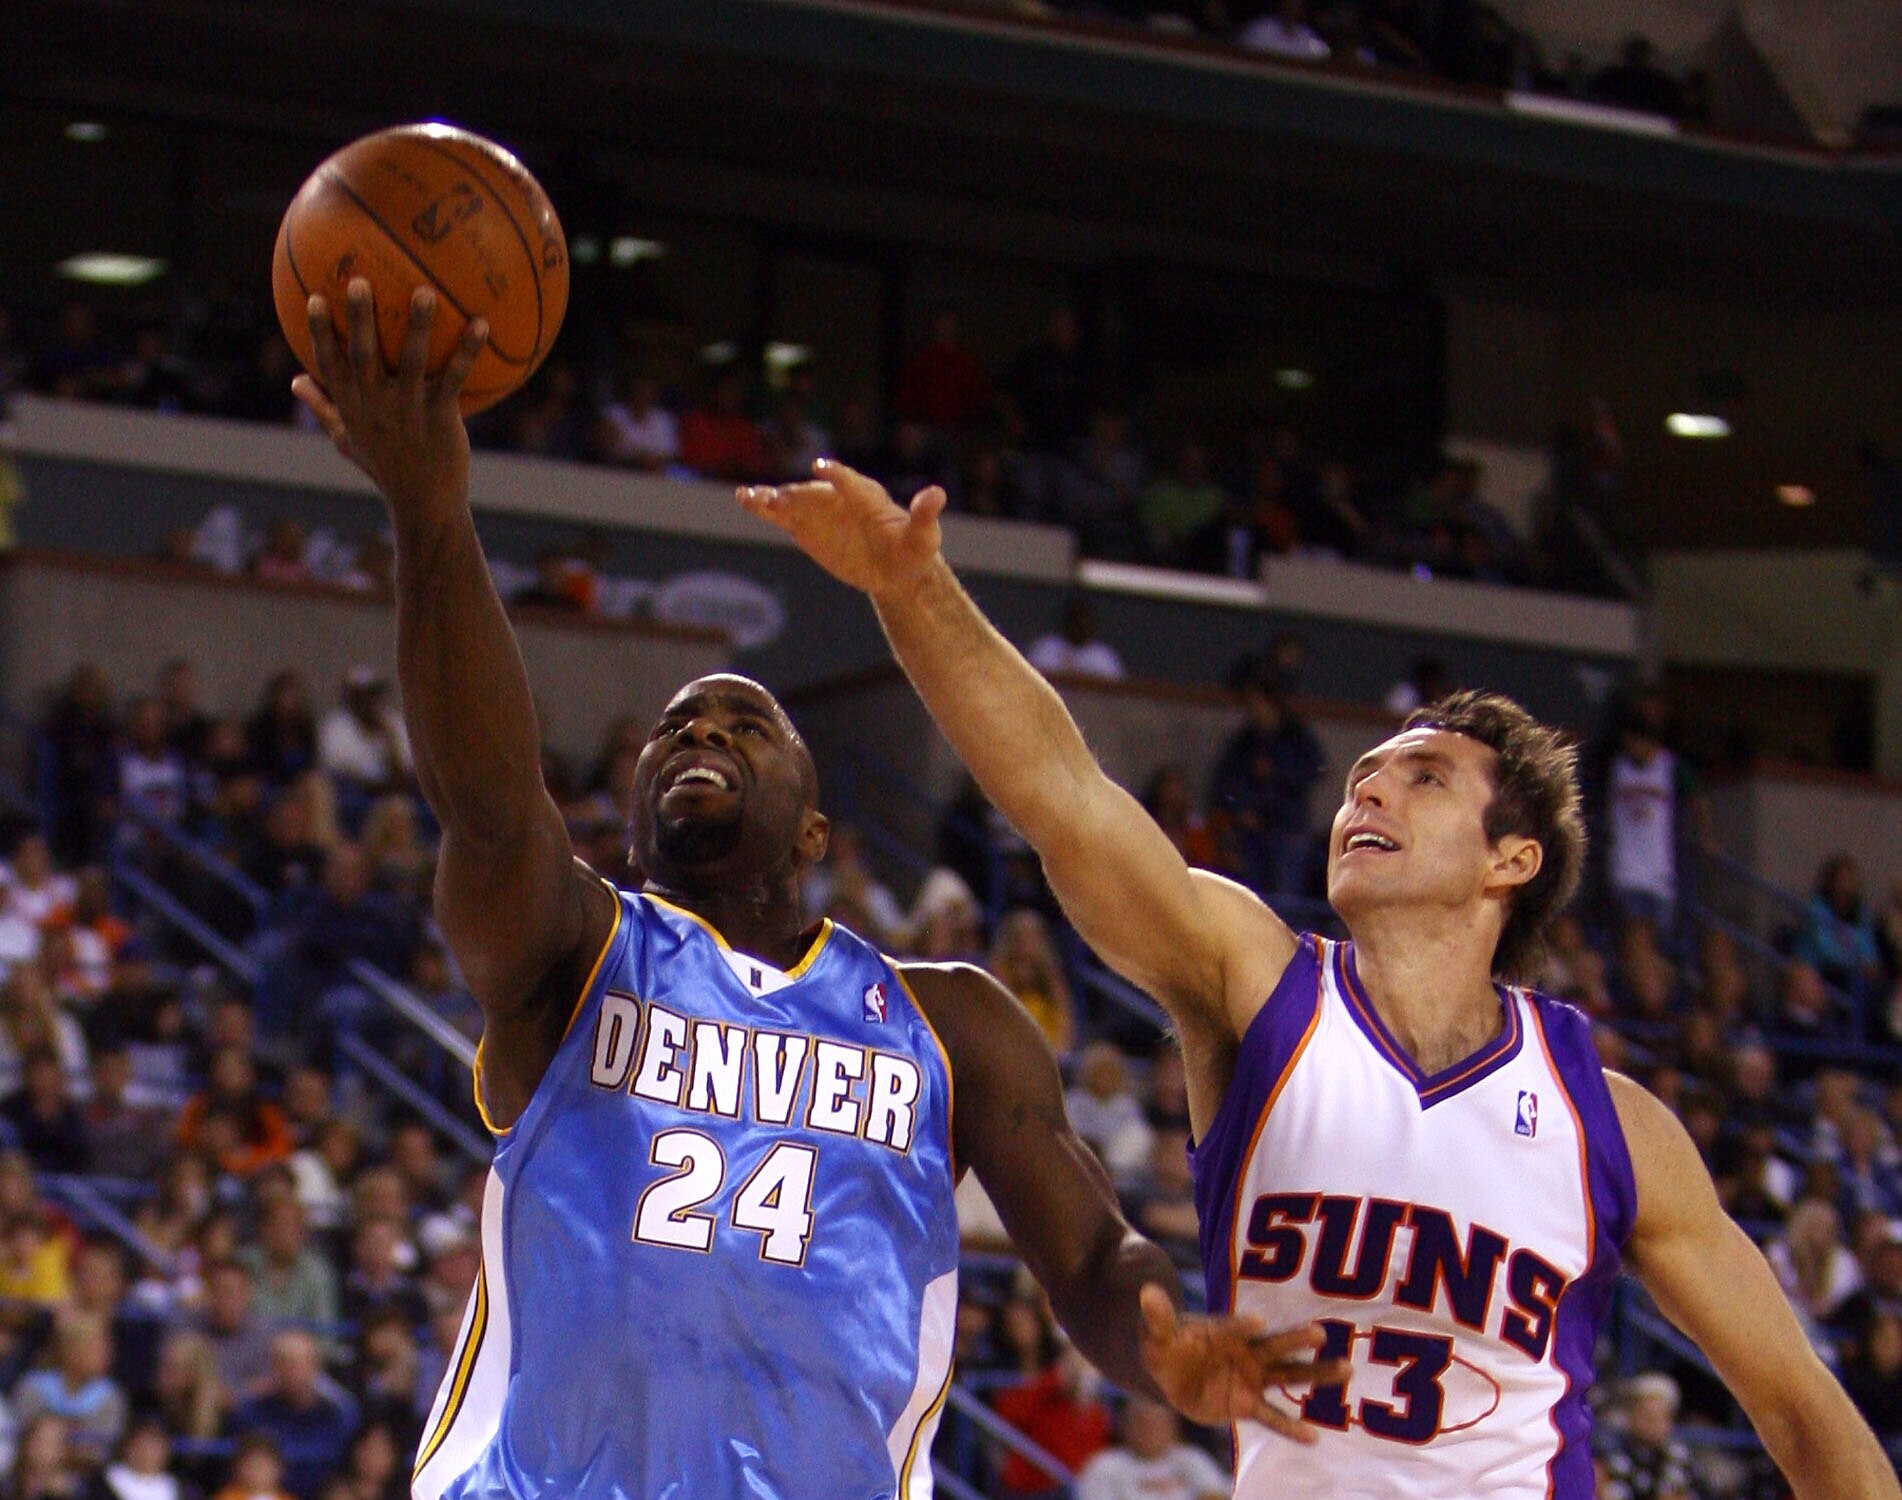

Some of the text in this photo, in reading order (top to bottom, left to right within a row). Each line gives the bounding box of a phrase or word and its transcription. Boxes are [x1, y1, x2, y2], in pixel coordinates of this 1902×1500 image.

[590, 990, 922, 1156] DENVER
[632, 1126, 819, 1267] 24
[1239, 1191, 1568, 1363] SUNS
[1301, 1317, 1454, 1446] 13
